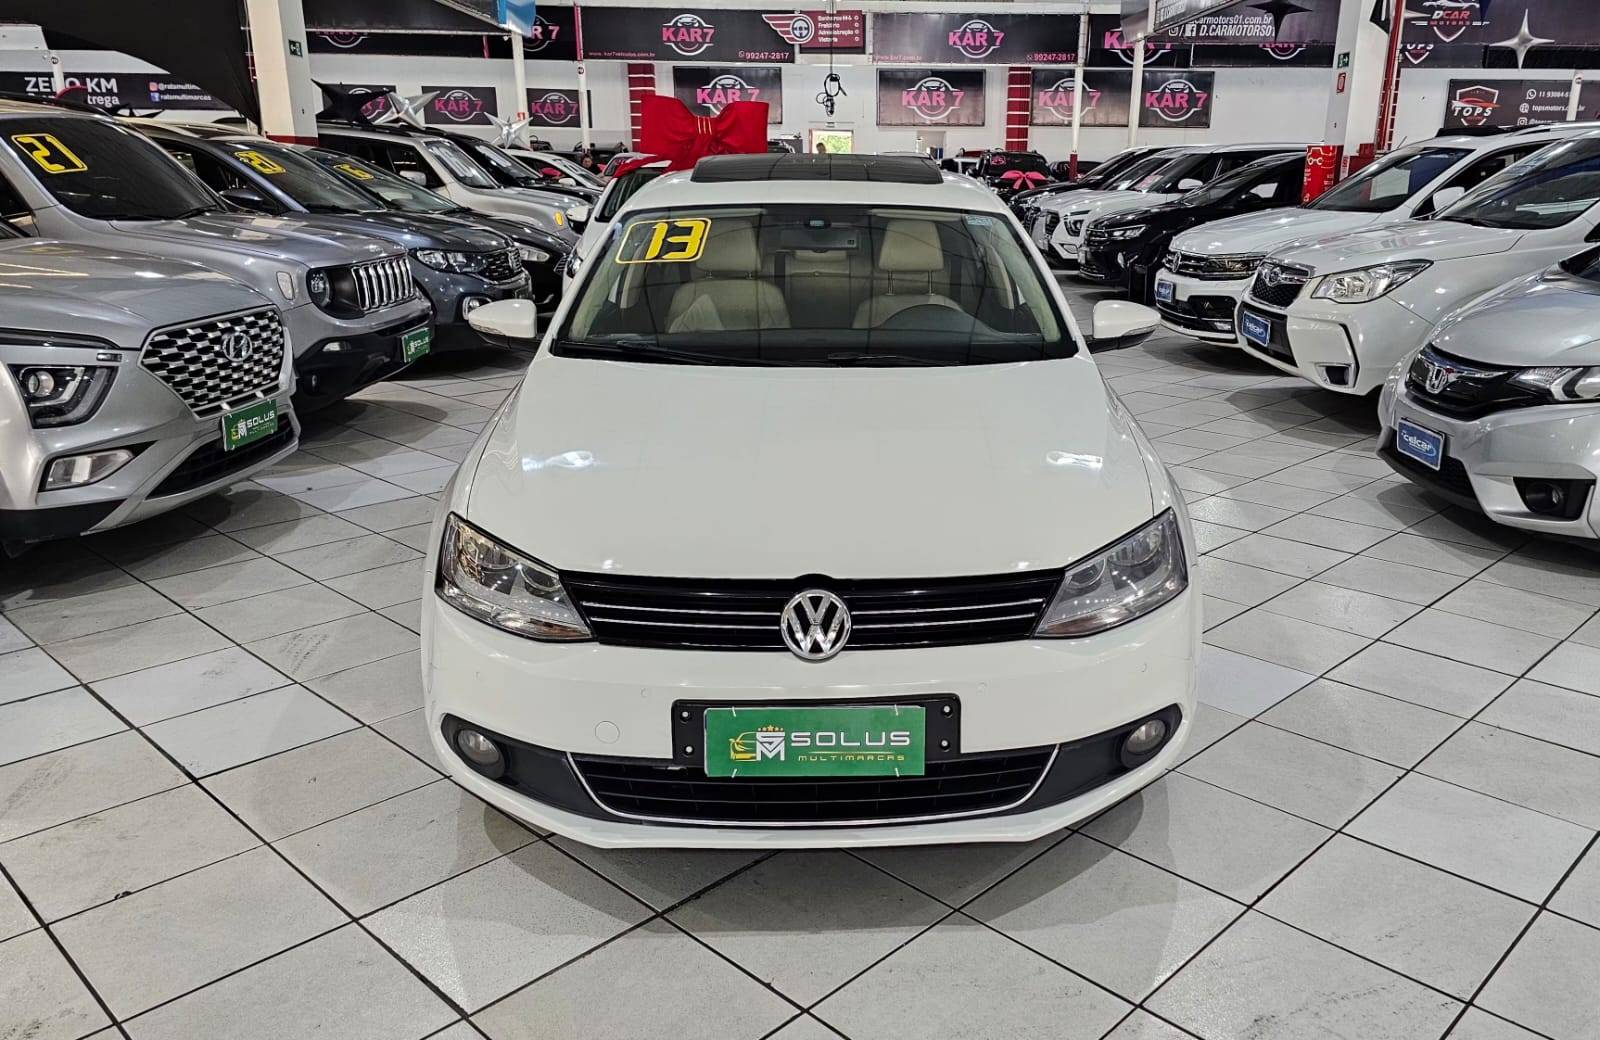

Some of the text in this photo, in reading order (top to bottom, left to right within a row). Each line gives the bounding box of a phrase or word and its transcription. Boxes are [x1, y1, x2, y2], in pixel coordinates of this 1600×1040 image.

[1190, 14, 1272, 24] carmotors01.com.br
[1432, 10, 1470, 19] DCAR
[949, 32, 1005, 46] KAR 7
[24, 77, 118, 93] ZEO KM
[697, 89, 760, 104] KAR 7
[901, 91, 965, 106] KAR 7
[1089, 92, 1101, 106] 7
[1145, 92, 1208, 107] KAR 7
[434, 99, 484, 112] KAR 7
[531, 103, 578, 115] KAR 7
[1453, 107, 1493, 117] TOPS
[16, 136, 84, 170] 21
[645, 221, 706, 260] 13
[246, 410, 275, 428] SOLUS
[791, 731, 910, 746] SOLUS
